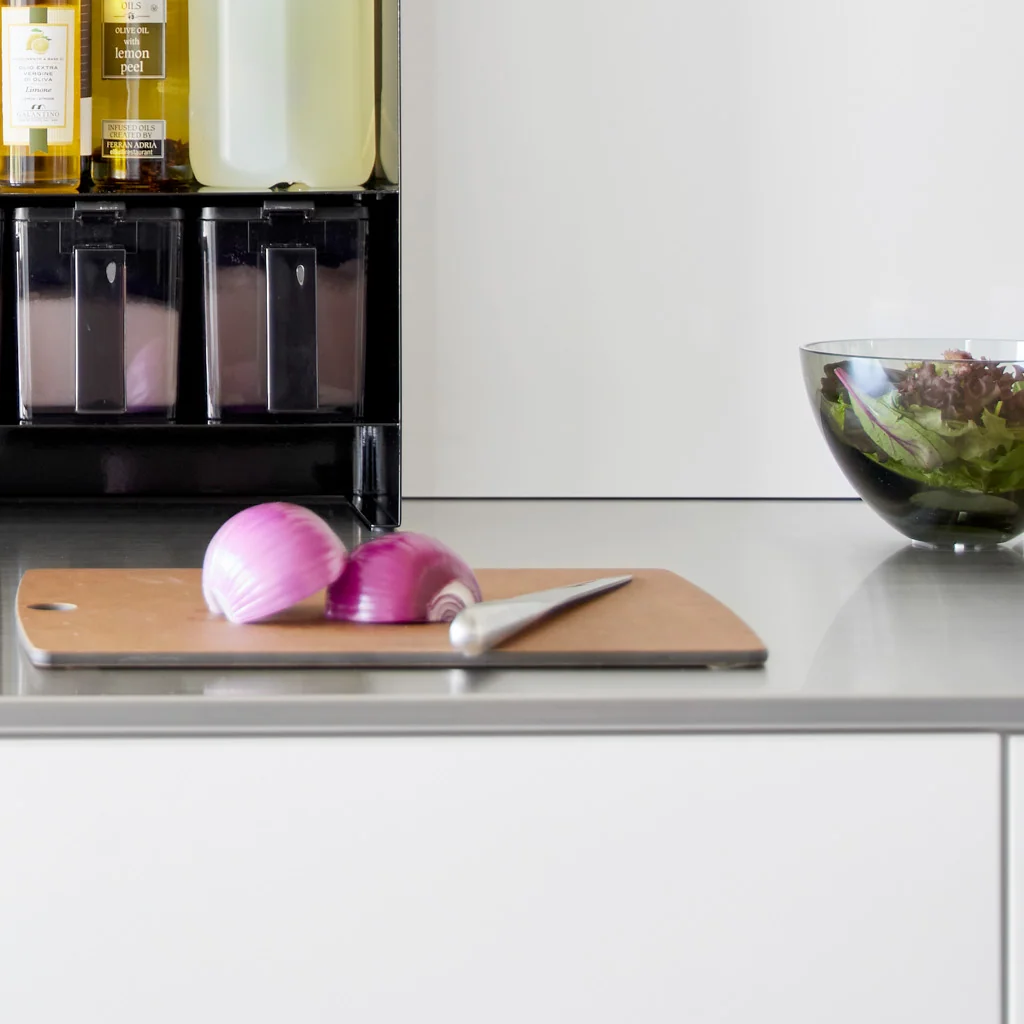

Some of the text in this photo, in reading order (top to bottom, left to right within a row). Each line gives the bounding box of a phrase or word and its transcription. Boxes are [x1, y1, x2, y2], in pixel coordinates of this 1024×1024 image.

[121, 1, 142, 10] OILS
[123, 37, 140, 46] with
[115, 47, 150, 59] lemon
[120, 60, 144, 75] peel
